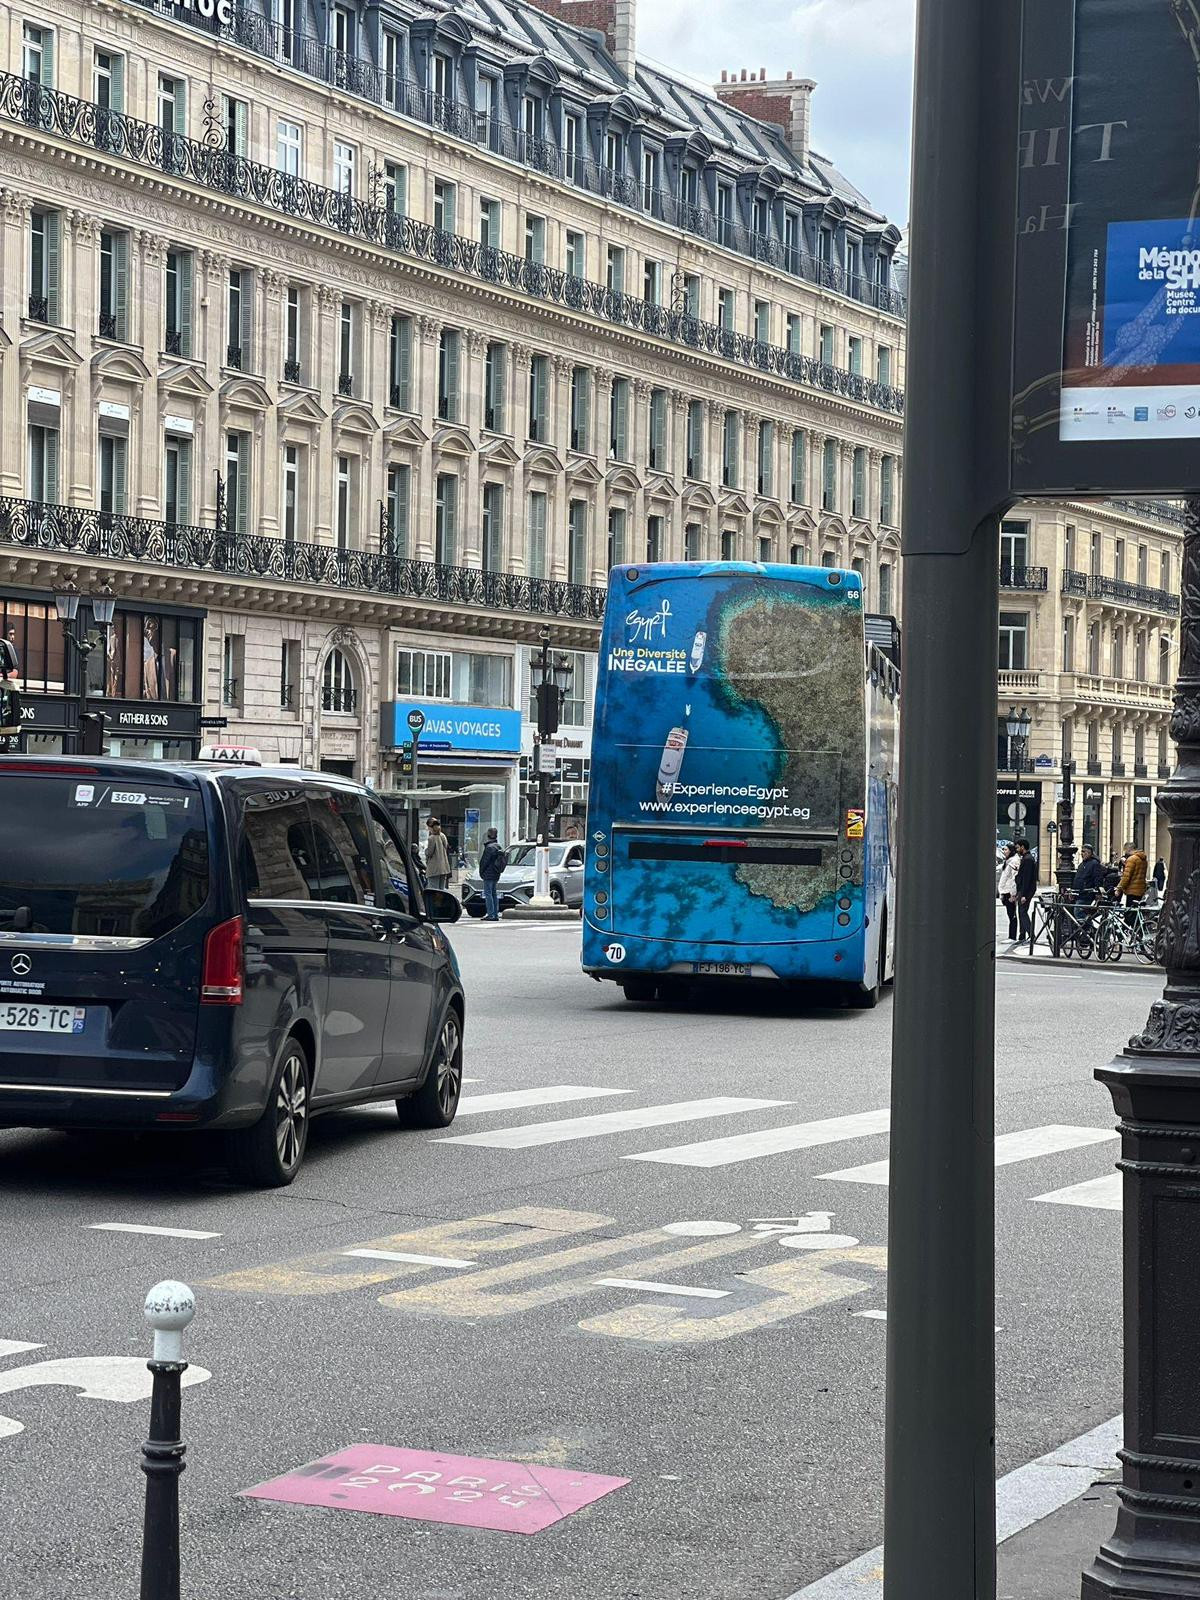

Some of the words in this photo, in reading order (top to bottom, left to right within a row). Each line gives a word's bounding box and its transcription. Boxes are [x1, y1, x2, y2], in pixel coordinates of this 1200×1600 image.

[1139, 268, 1153, 280] de
[1154, 268, 1165, 279] la
[1166, 298, 1195, 307] Centre
[1166, 306, 1177, 314] de
[847, 590, 859, 599] 56
[612, 647, 635, 657] Une
[637, 648, 687, 659] Diversité
[20, 707, 35, 719] ONS
[409, 714, 422, 723] BUS
[454, 721, 501, 737] VOYAGES
[210, 748, 246, 760] TAXI
[661, 782, 789, 800] #ExperienceEgypt
[114, 793, 142, 803] 3607
[639, 801, 811, 820] www.experienceegypt.eg
[610, 946, 622, 960] 70
[73, 1020, 84, 1030] 75
